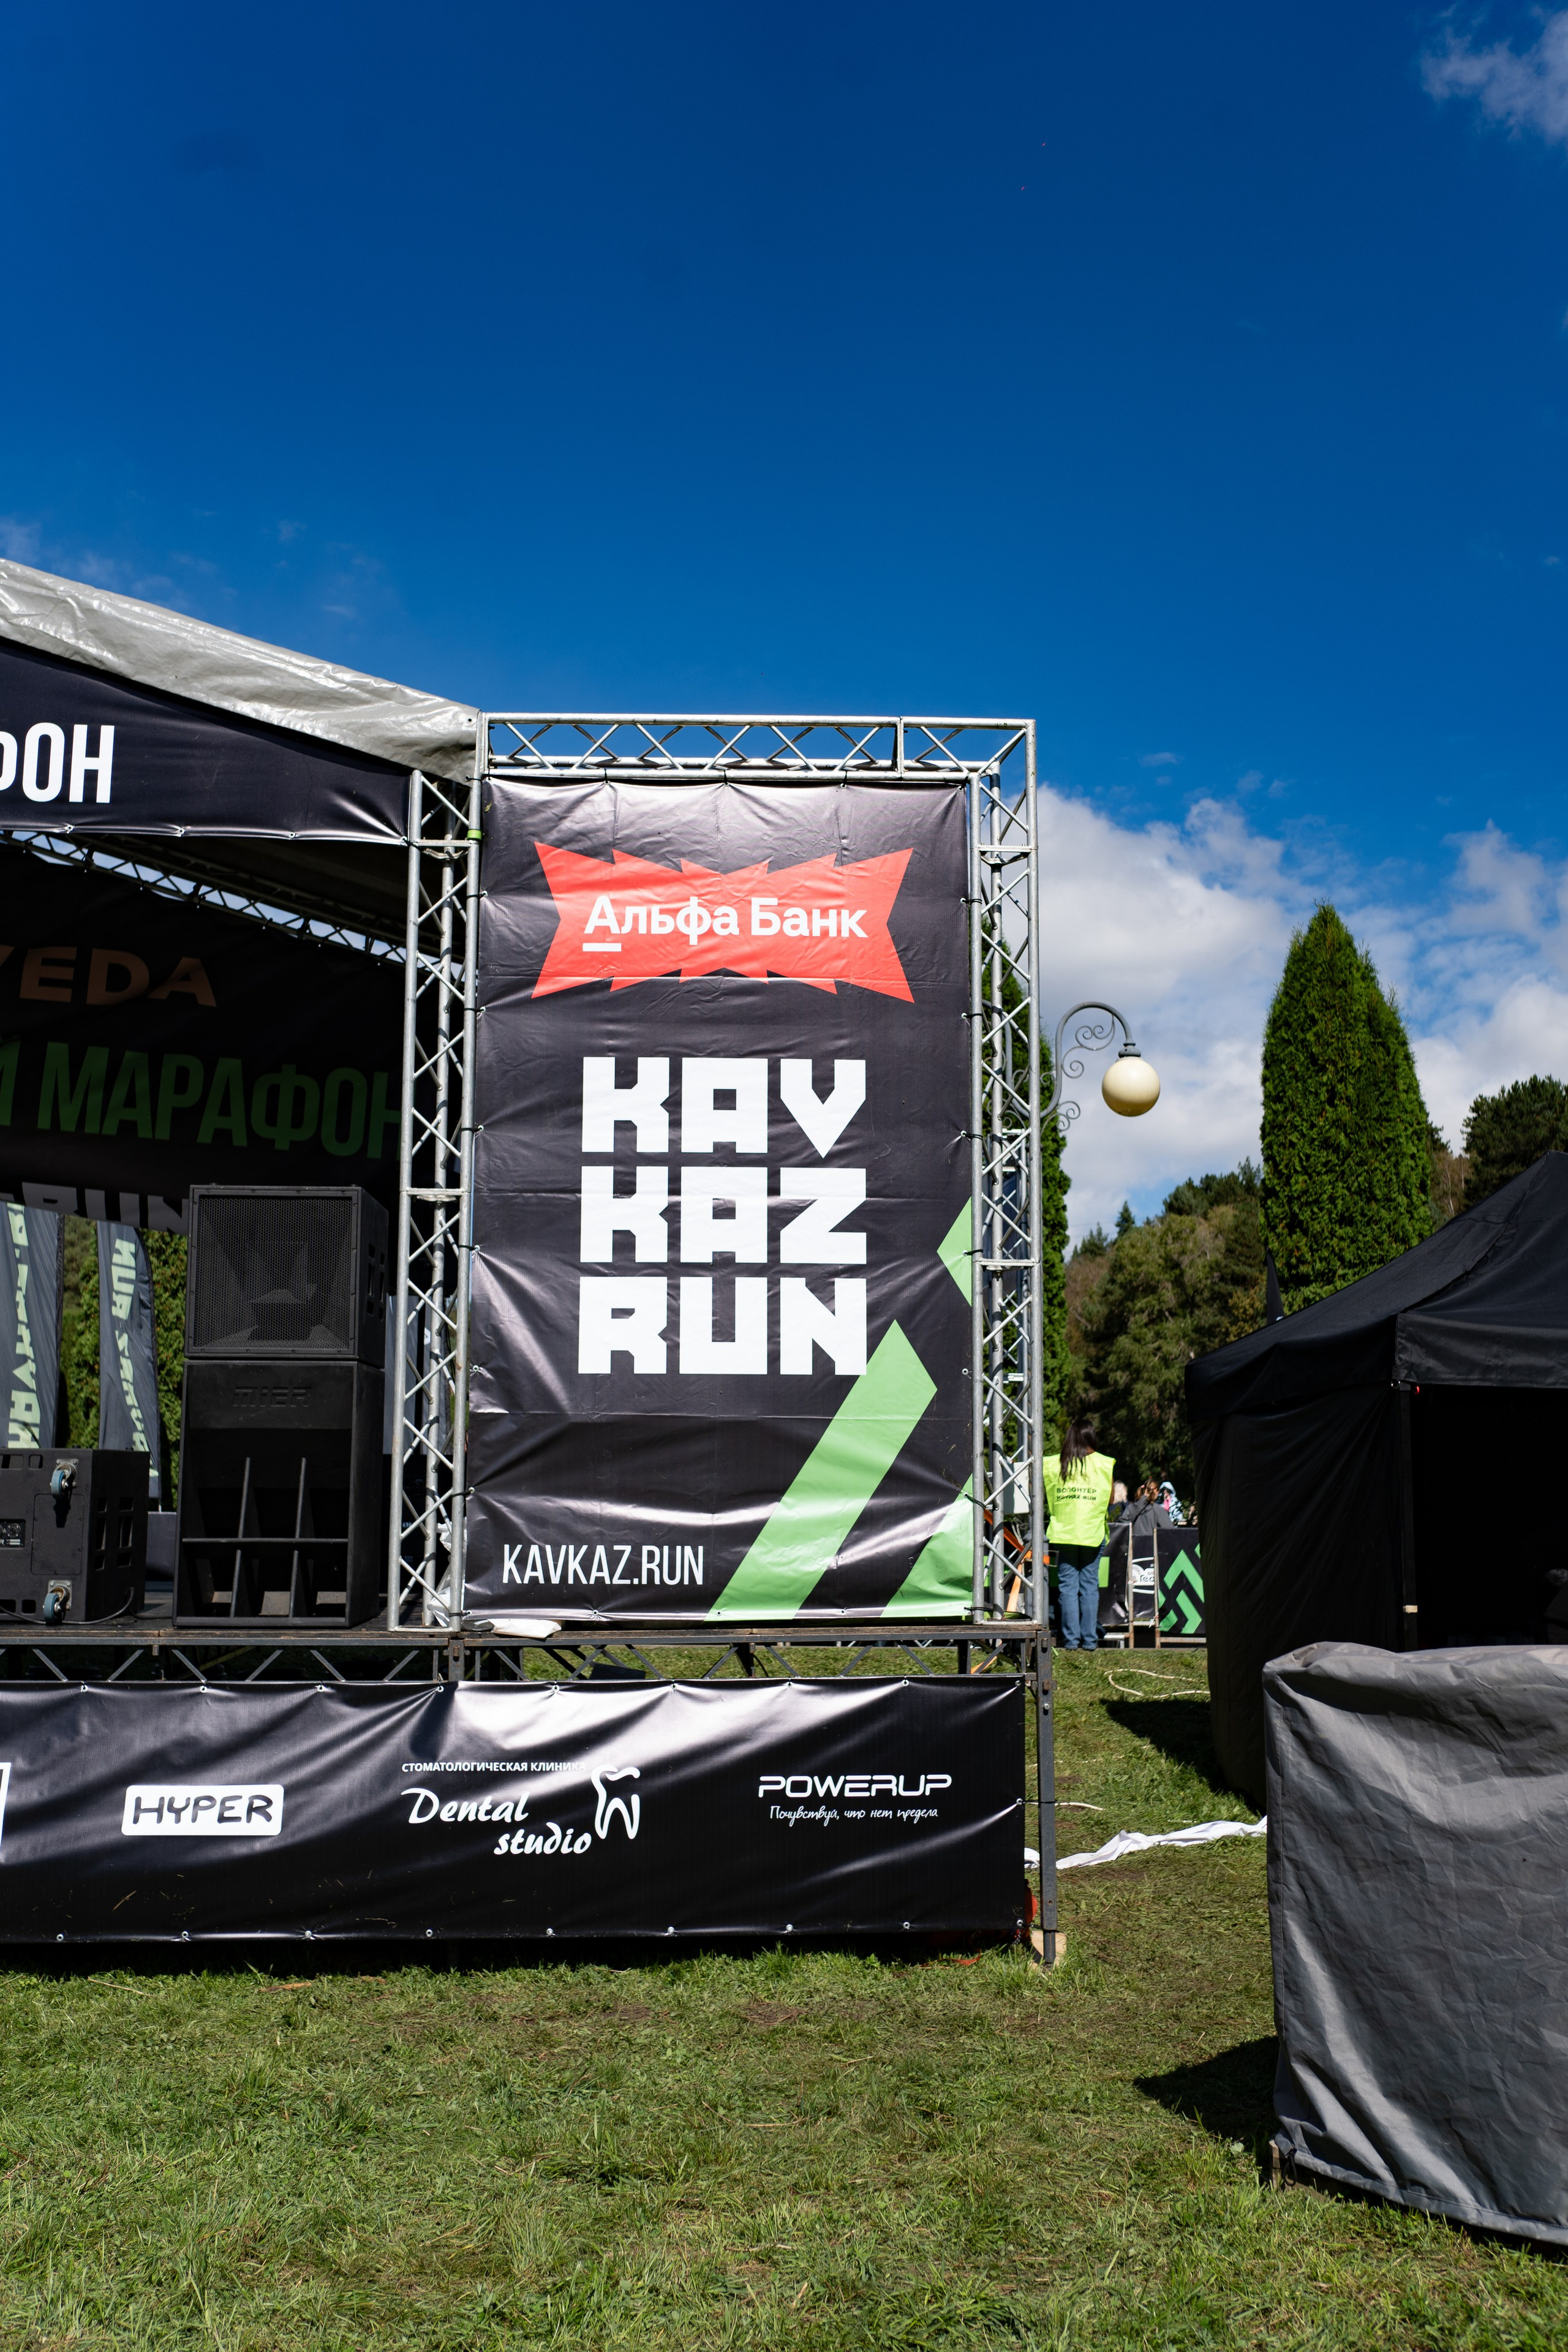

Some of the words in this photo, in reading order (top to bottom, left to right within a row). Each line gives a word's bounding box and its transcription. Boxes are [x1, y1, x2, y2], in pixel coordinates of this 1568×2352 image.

[0, 723, 115, 804] ОН
[582, 895, 740, 948] Альфа
[751, 897, 869, 938] Банк
[37, 1041, 402, 1161] МАРАФОН
[581, 1057, 867, 1158] KAV
[580, 1166, 867, 1265] KAZ
[578, 1276, 867, 1376] RUN
[502, 1544, 704, 1585] KAVKAZ.RUN
[402, 1762, 527, 1773] СТОМАТОЛОГИЧЕСКАЯ
[530, 1762, 586, 1771] КЛИНИКА
[758, 1774, 952, 1798] POWERUP
[132, 1795, 273, 1824] HYPER
[401, 1787, 530, 1824] Dental
[770, 1806, 840, 1827] Почувствуй,
[844, 1810, 866, 1820] что
[870, 1810, 892, 1819] нет
[897, 1809, 938, 1824] предела
[494, 1822, 592, 1855] studio
